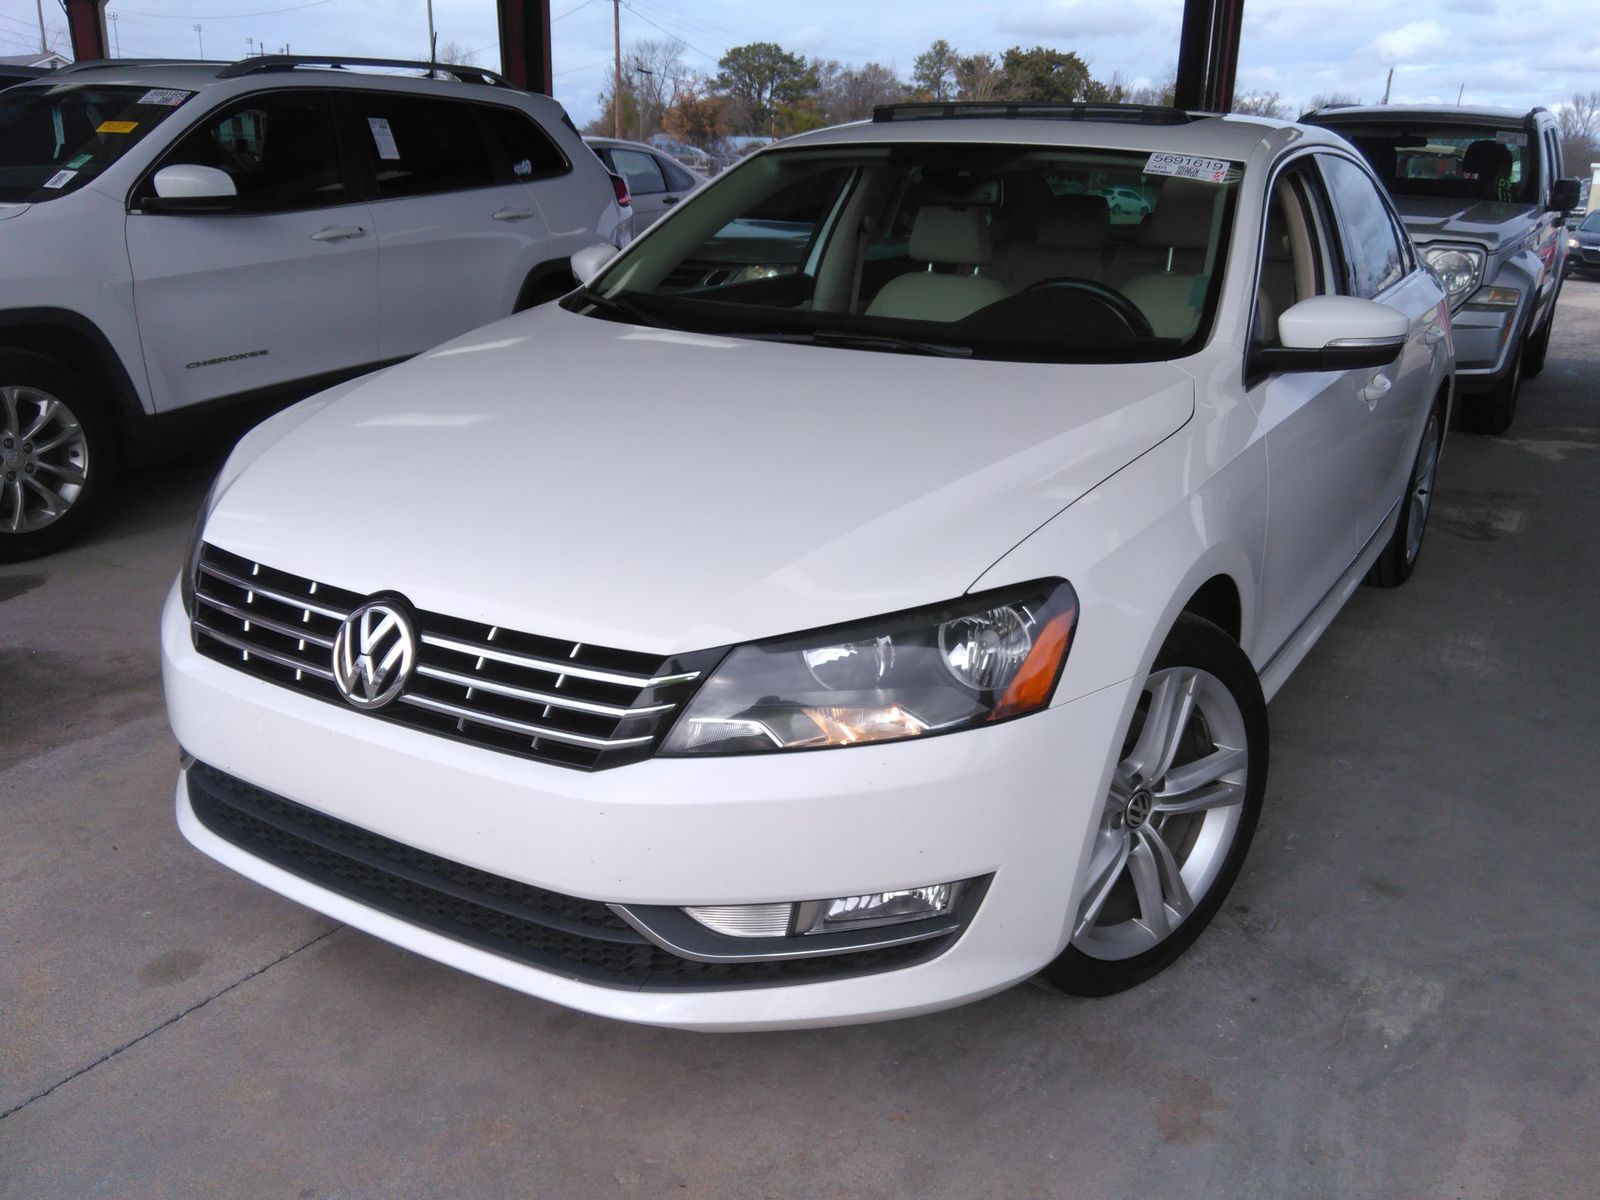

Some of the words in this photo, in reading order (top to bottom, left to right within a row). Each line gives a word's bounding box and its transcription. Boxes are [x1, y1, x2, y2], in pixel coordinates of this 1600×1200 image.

[1153, 154, 1224, 170] 5691619
[186, 349, 269, 369] CHEROKEE
[339, 605, 408, 704] VW
